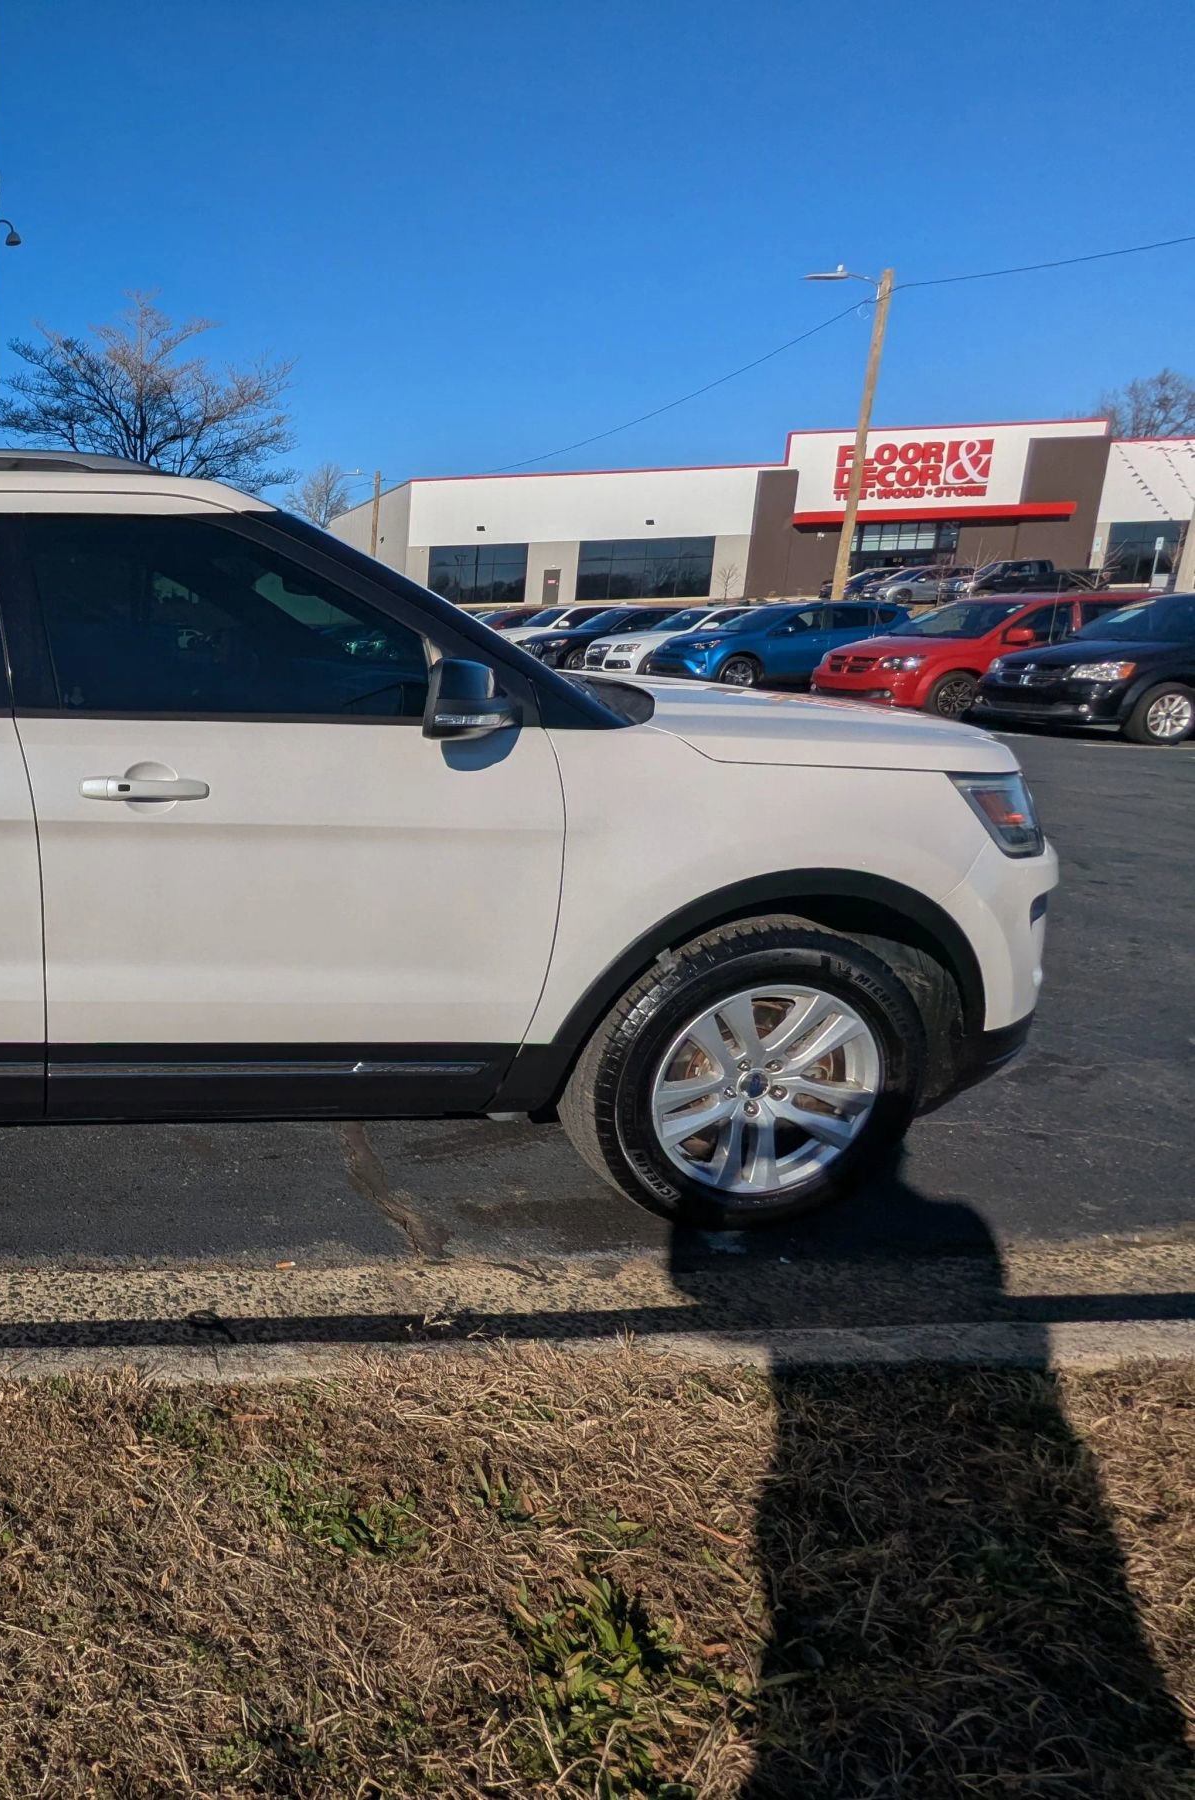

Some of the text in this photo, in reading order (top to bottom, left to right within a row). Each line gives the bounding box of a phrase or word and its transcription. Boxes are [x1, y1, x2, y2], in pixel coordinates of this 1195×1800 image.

[833, 463, 943, 489] DECOR
[876, 486, 925, 499] WOOD
[933, 485, 988, 498] STONE
[632, 1151, 681, 1201] ICHELIN
